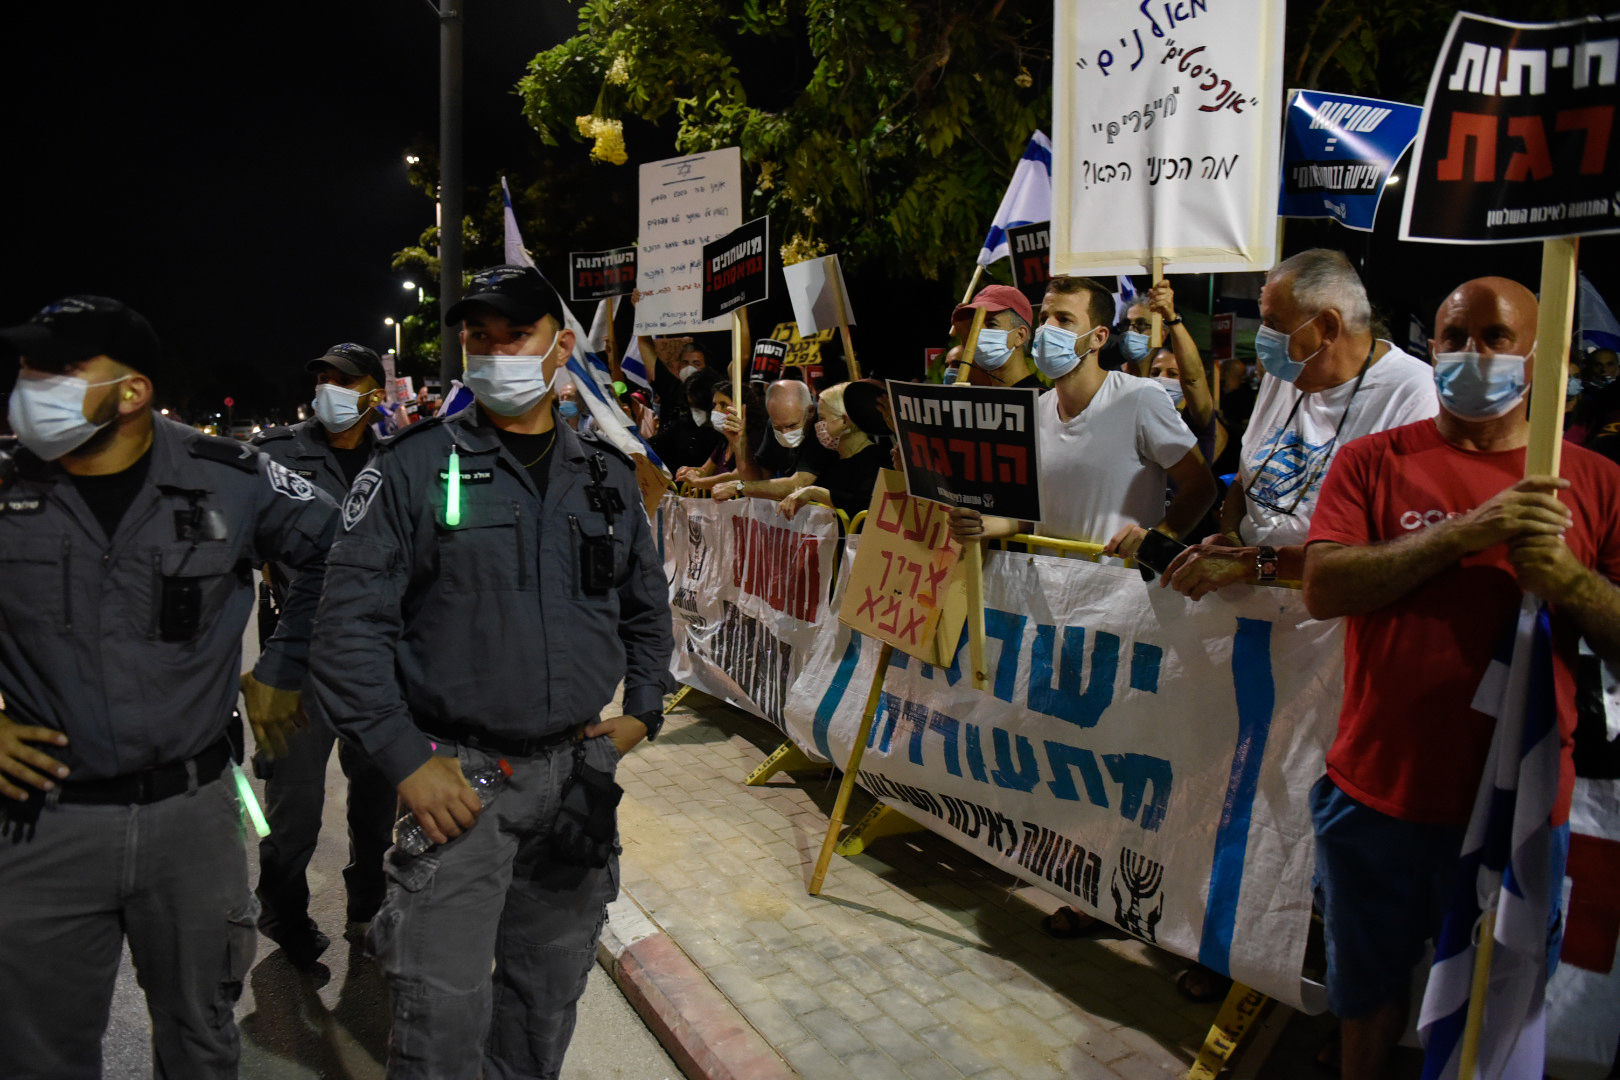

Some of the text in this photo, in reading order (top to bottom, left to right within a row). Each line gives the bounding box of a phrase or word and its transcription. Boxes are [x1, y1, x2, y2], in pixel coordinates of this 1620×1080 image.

[1448, 38, 1619, 97] חיתות
[1309, 101, 1393, 133] שחיתות
[1436, 105, 1616, 183] רגת
[1082, 154, 1239, 190] מה הכינוי הבא?
[1344, 165, 1381, 189] פגיעה
[1486, 198, 1610, 228] התנועה לאיכות השלטון
[576, 252, 635, 269] השחיתות
[577, 265, 635, 288] הורגת
[712, 235, 763, 273] מושחתים
[898, 394, 1025, 433] השחיתות
[908, 431, 1029, 486] הורגת
[878, 550, 948, 609] צריך
[855, 585, 928, 646] אמא
[888, 607, 1163, 729] ישר
[938, 792, 1018, 857] לאיכות
[1017, 821, 1102, 908] התנועה
